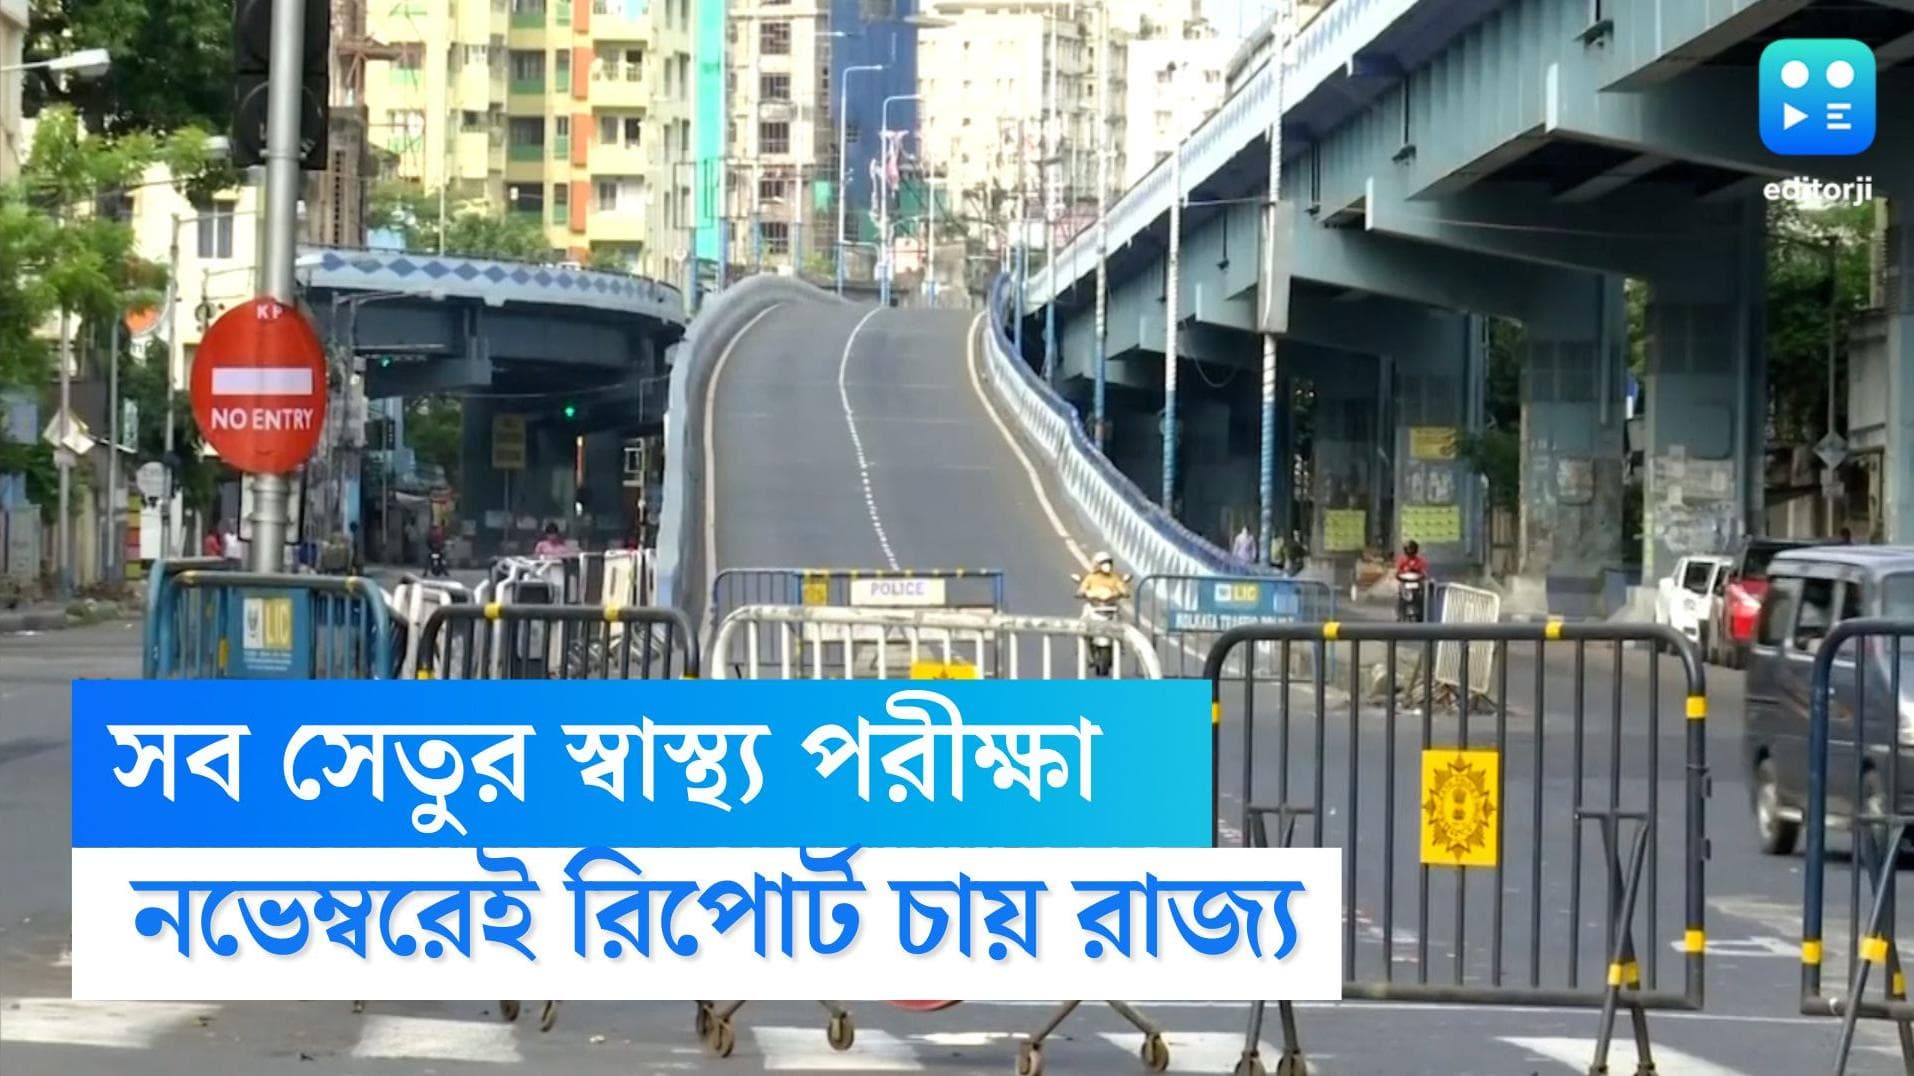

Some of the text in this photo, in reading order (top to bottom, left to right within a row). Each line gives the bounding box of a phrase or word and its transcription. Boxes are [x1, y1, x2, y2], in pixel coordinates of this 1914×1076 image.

[211, 407, 313, 430] NO ENTRY
[870, 581, 924, 596] POLICE
